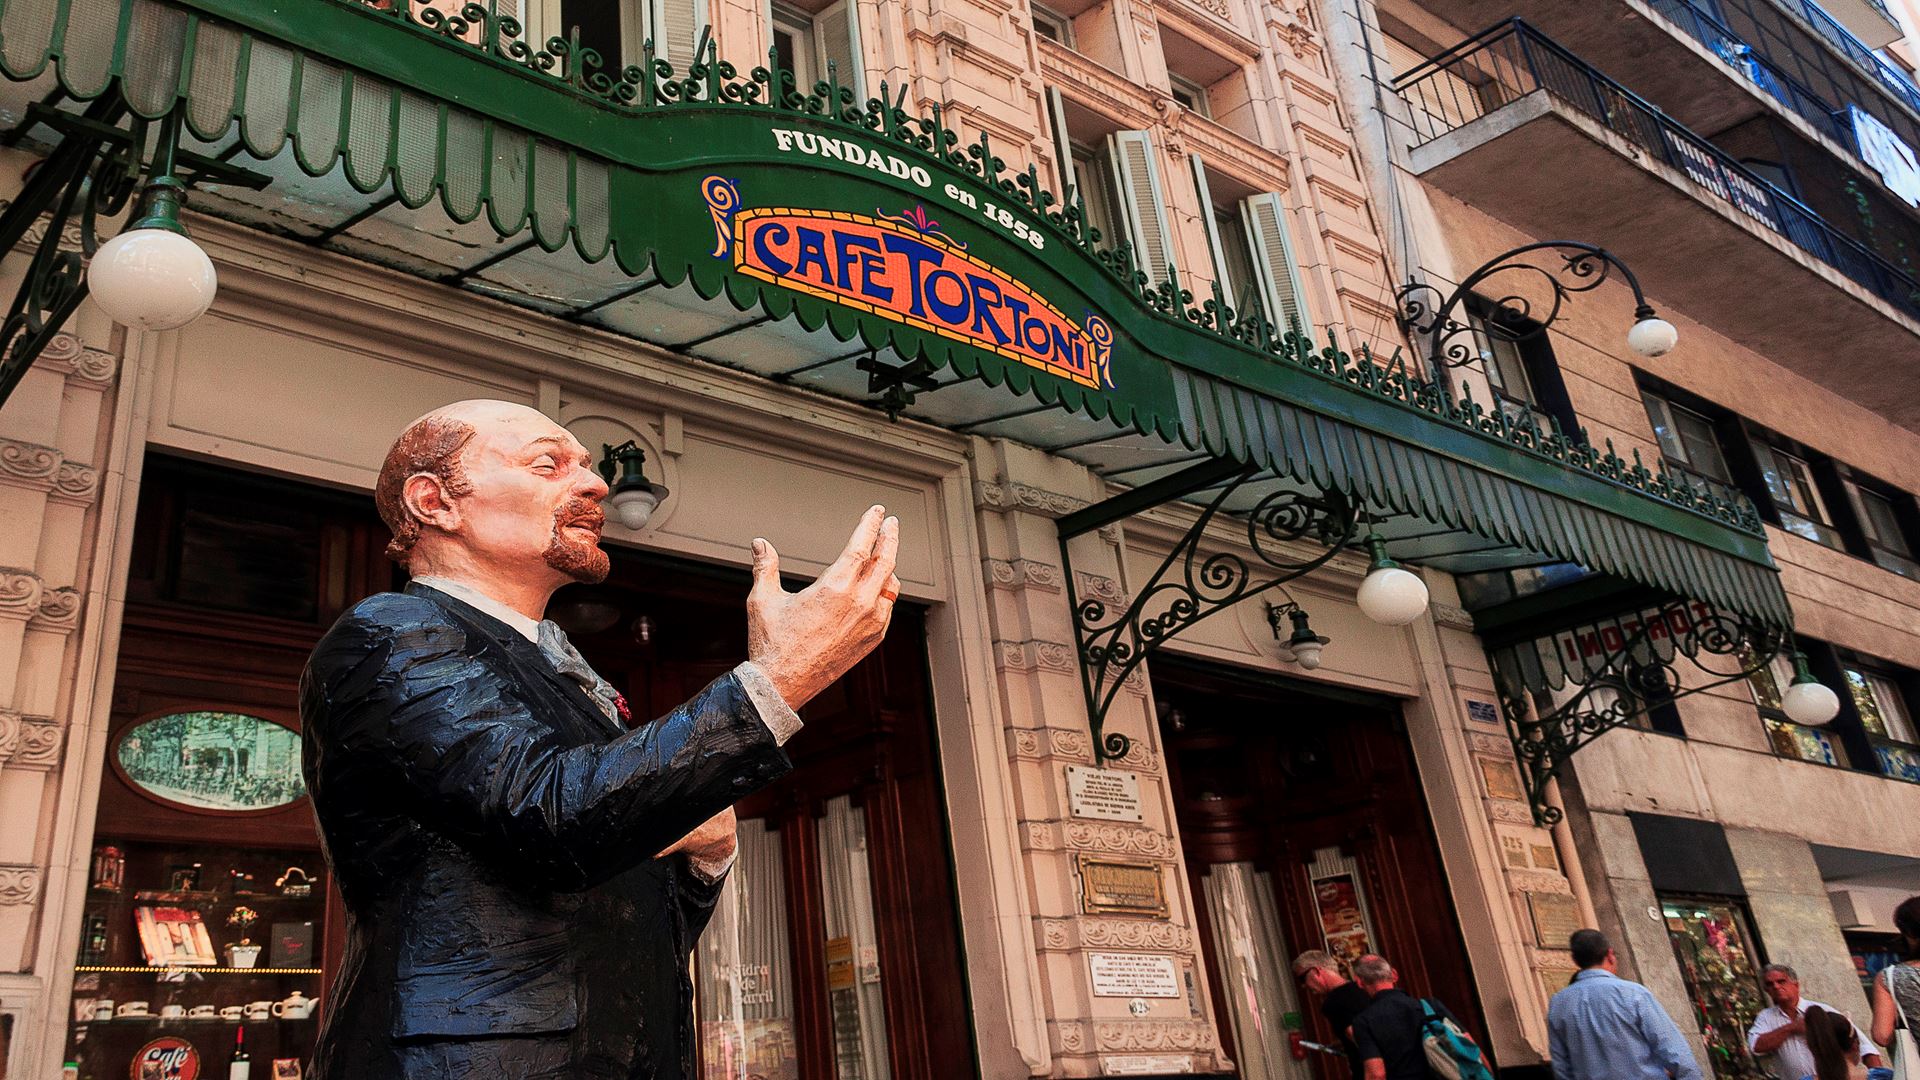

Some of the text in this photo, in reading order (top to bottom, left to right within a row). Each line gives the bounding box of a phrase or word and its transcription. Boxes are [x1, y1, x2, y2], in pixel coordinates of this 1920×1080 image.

[771, 128, 1045, 250] FUNDADO en 1858
[753, 223, 1086, 371] CAFE TORTONI
[736, 988, 774, 1004] arril
[741, 977, 756, 991] de
[143, 1046, 192, 1072] Café
